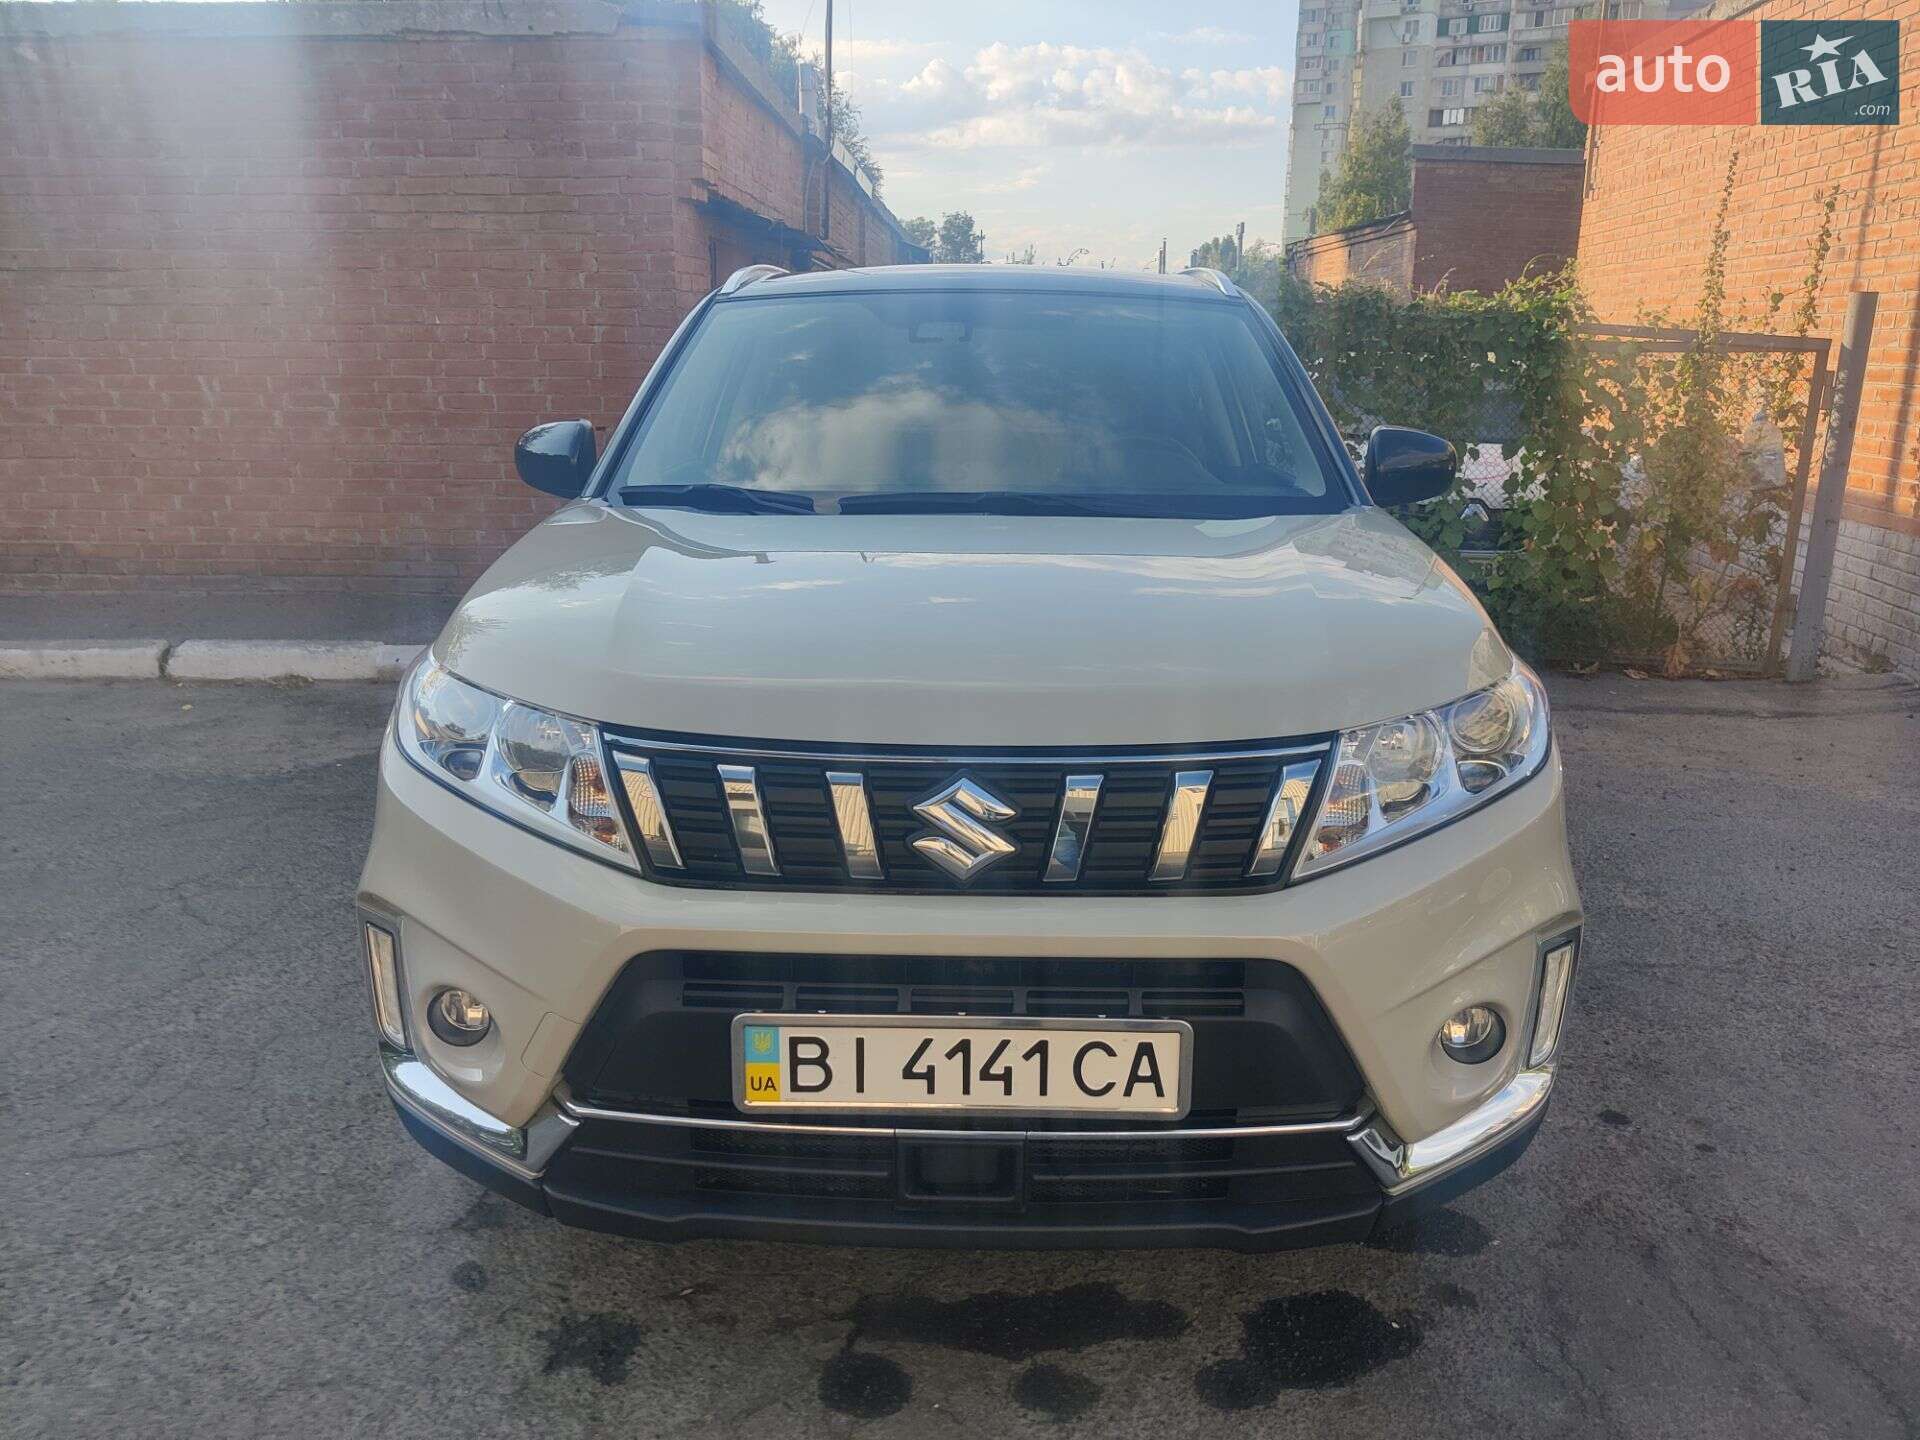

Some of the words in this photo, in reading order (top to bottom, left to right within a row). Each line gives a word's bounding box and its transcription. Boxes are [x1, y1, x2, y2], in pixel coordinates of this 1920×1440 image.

[750, 1075, 777, 1092] UA
[788, 1036, 865, 1094] BI
[902, 1037, 1049, 1097] 4141
[1072, 1040, 1165, 1098] CA
